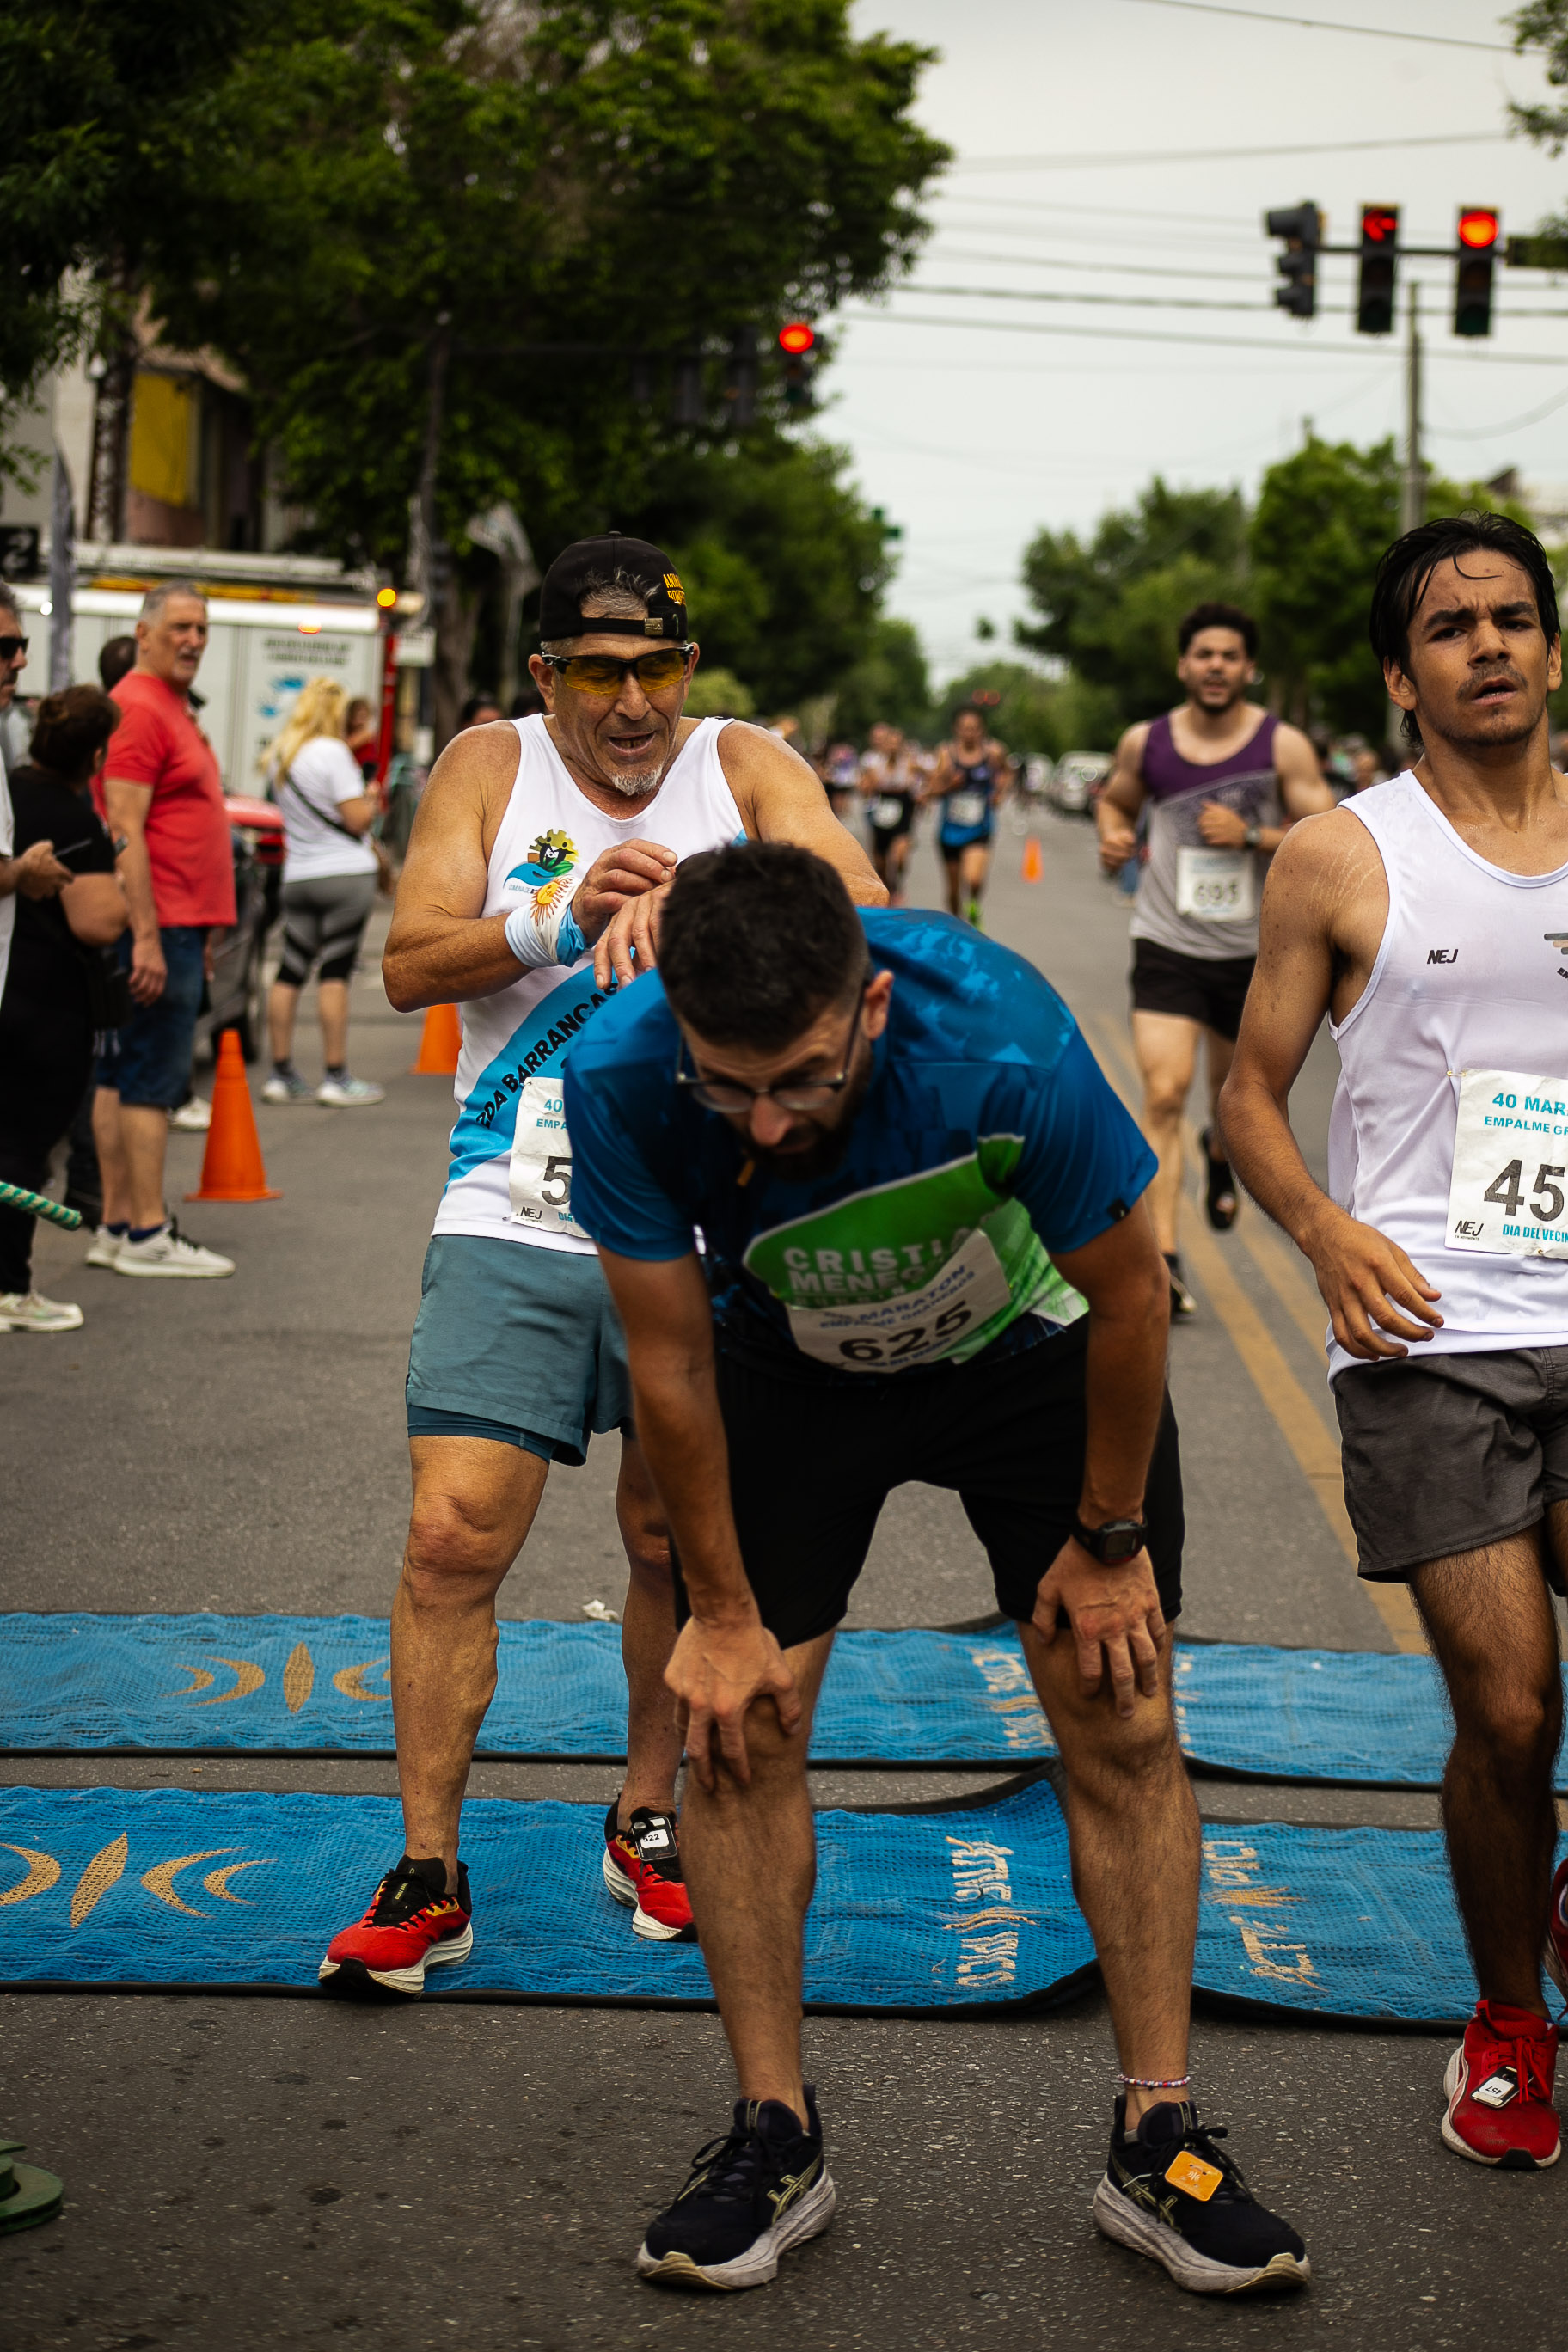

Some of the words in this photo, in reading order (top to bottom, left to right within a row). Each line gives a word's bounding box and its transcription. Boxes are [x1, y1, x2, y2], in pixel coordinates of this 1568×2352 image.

[1426, 949, 1459, 965] NEJ
[544, 1099, 563, 1112] 40
[1491, 1093, 1517, 1109] 40
[1524, 1096, 1568, 1116] MAR
[1484, 1116, 1550, 1134] EMPALME
[1483, 1159, 1565, 1222] 45
[521, 1207, 542, 1220] NEJ
[1455, 1221, 1484, 1236] NEJ
[1502, 1224, 1521, 1236] DIA
[1522, 1227, 1540, 1239] DEL
[839, 1300, 972, 1361] 625
[1485, 2086, 1503, 2095] 457
